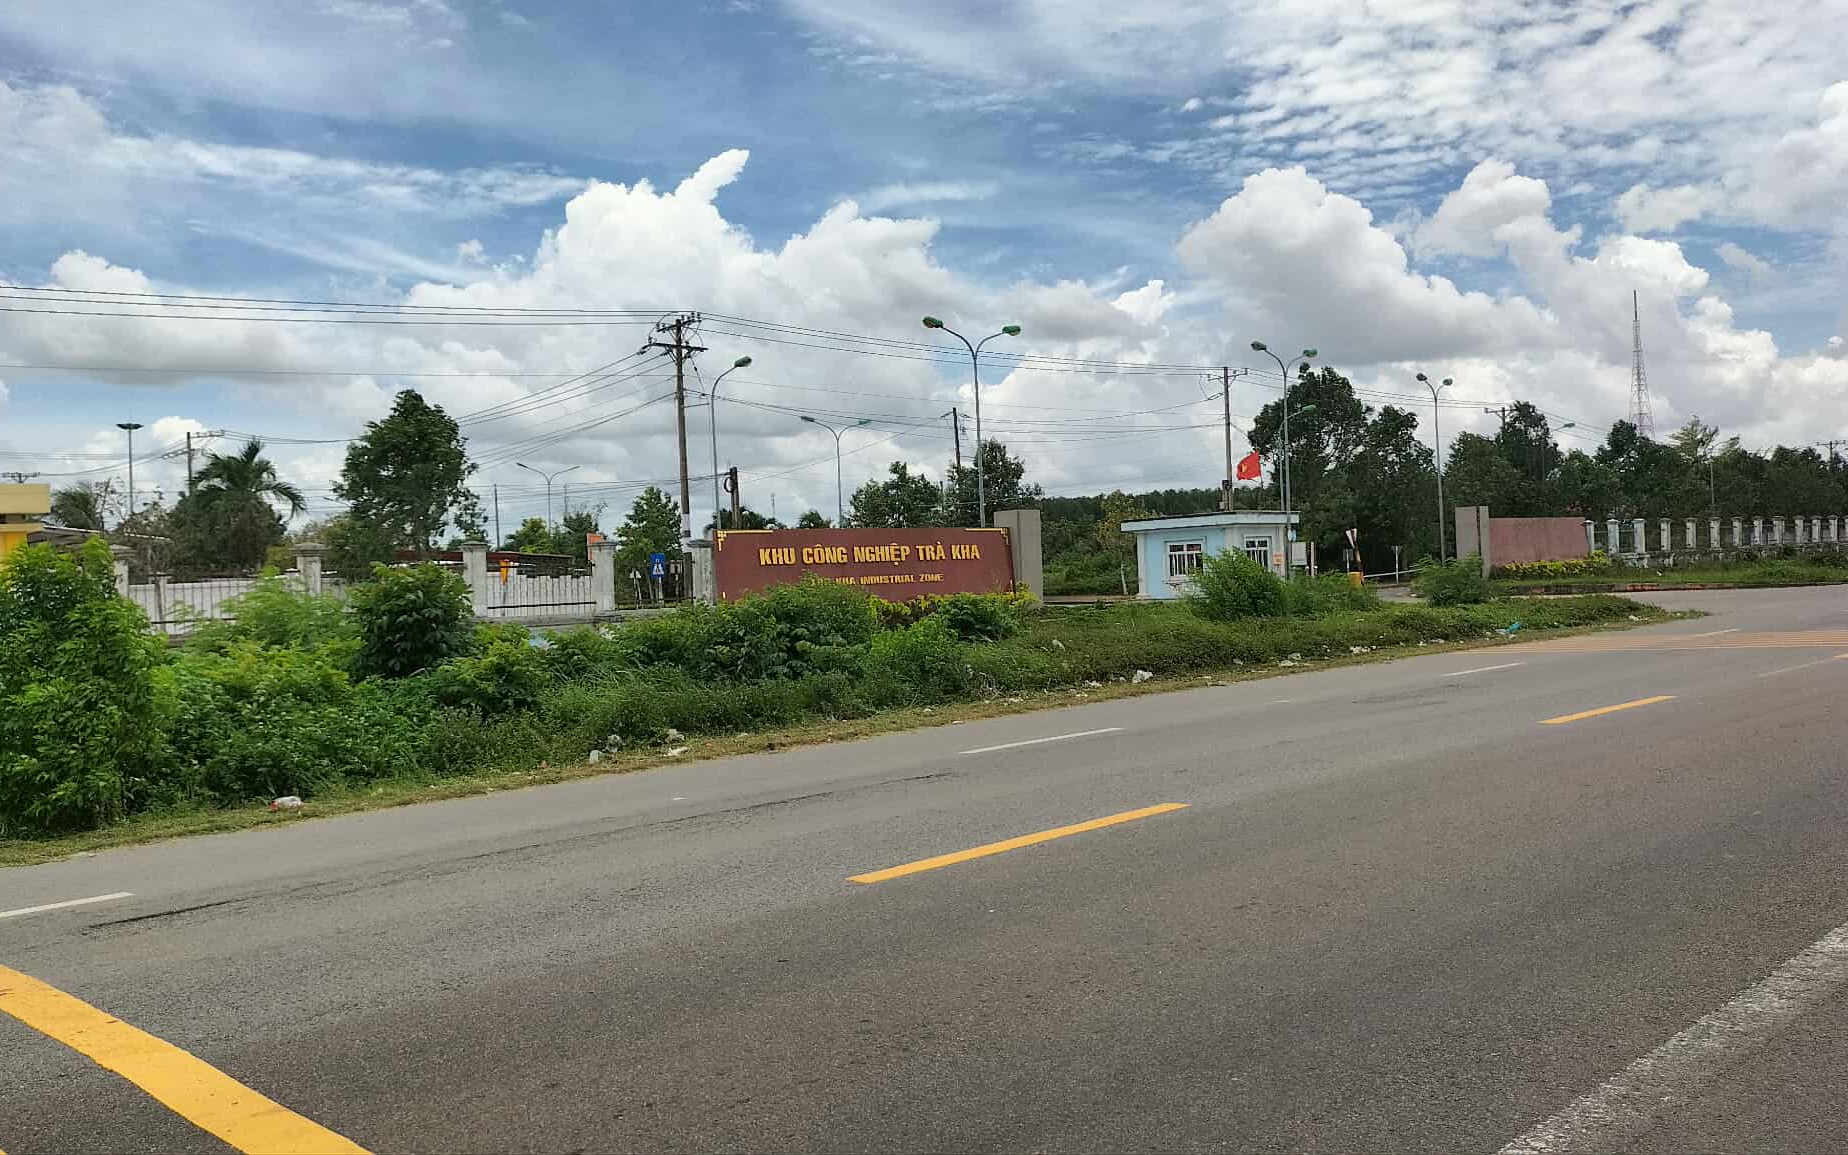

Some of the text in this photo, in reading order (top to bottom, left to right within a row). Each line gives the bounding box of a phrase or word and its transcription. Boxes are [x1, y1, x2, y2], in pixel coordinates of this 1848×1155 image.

[759, 541, 981, 566] KHU CÔNG NGHIỆP TRÀ KHA
[860, 574, 915, 585] INDUSTRIAL
[919, 573, 945, 583] ZONE
